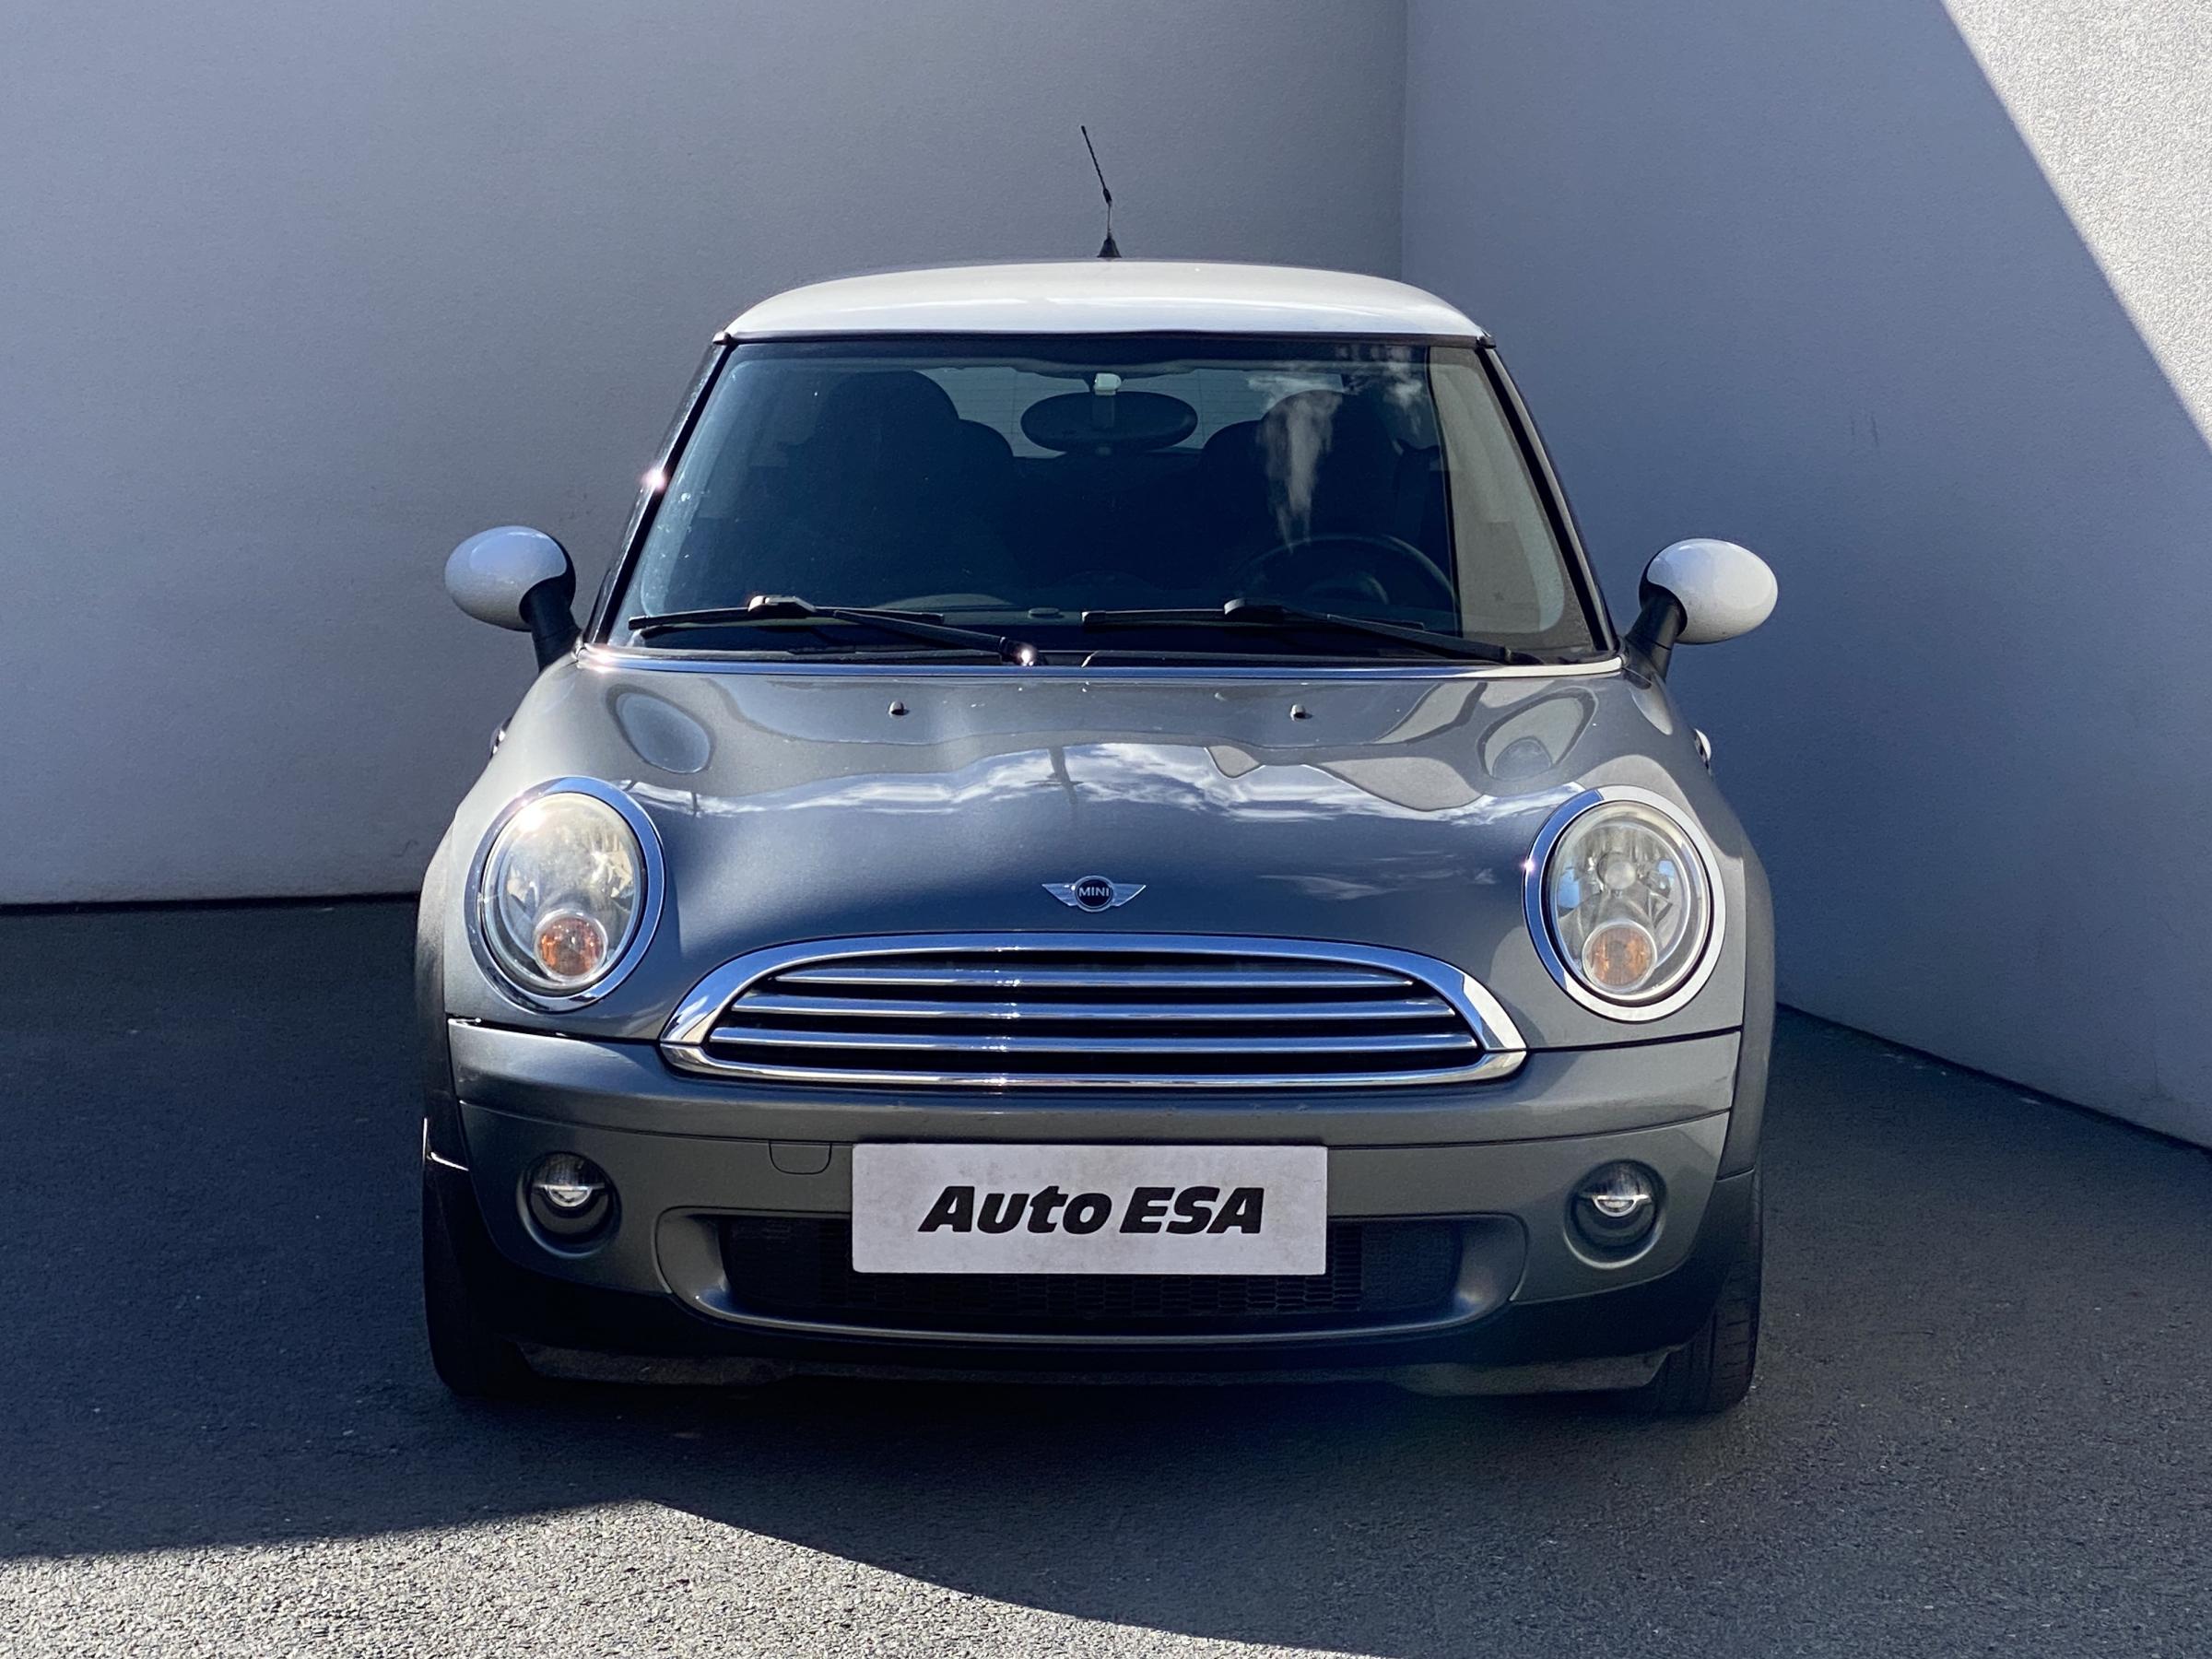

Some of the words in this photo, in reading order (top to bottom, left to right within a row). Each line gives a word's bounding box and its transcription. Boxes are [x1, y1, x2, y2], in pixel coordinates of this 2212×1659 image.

[1078, 887, 1110, 897] MINI
[918, 1185, 1112, 1235] Auto
[1119, 1185, 1265, 1235] ESA
